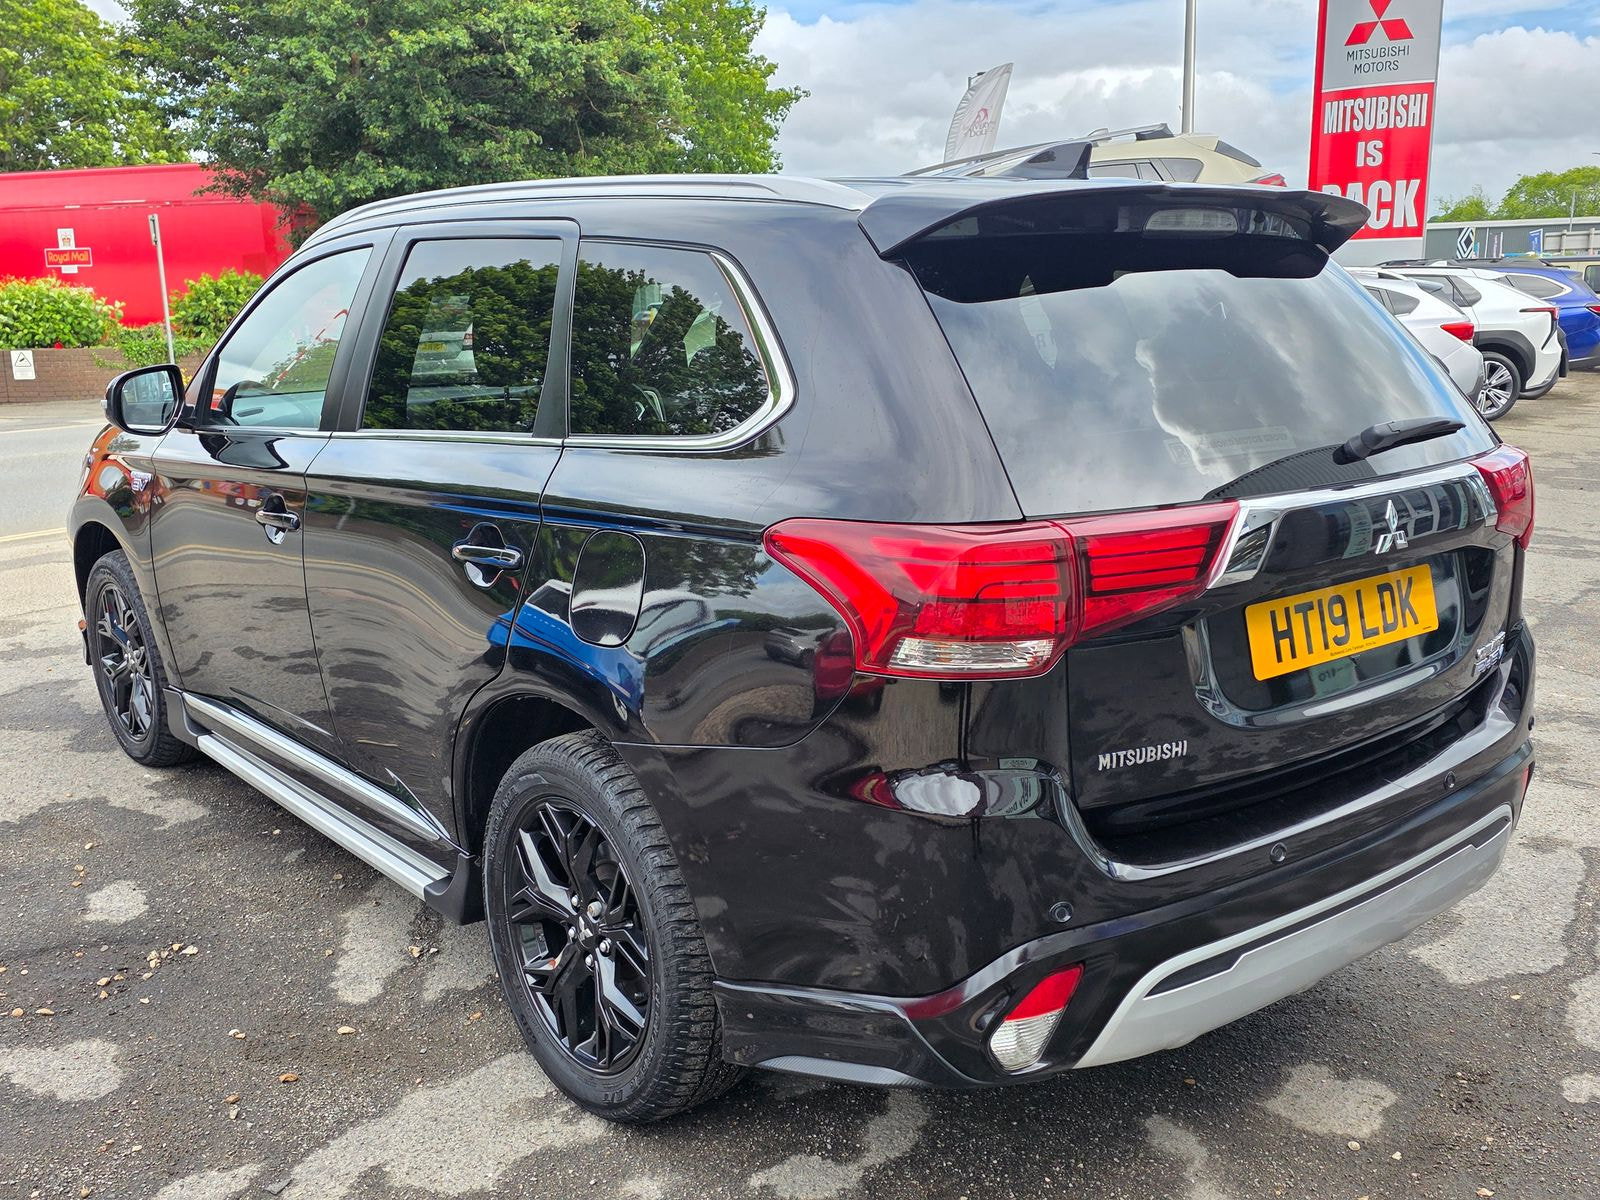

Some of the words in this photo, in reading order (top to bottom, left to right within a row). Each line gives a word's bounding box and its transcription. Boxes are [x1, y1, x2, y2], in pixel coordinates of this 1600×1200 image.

[1346, 45, 1410, 61] MITSUBISHI
[1353, 60, 1399, 74] MOTORS
[1323, 93, 1429, 134] MITSUBISHI
[1356, 140, 1384, 167] IS
[1321, 179, 1421, 230] CK
[47, 251, 70, 264] Royal
[71, 250, 89, 262] Mail
[1269, 594, 1351, 664] HT19
[1356, 576, 1420, 640] LDK
[1098, 740, 1187, 771] MITSUBISHI
